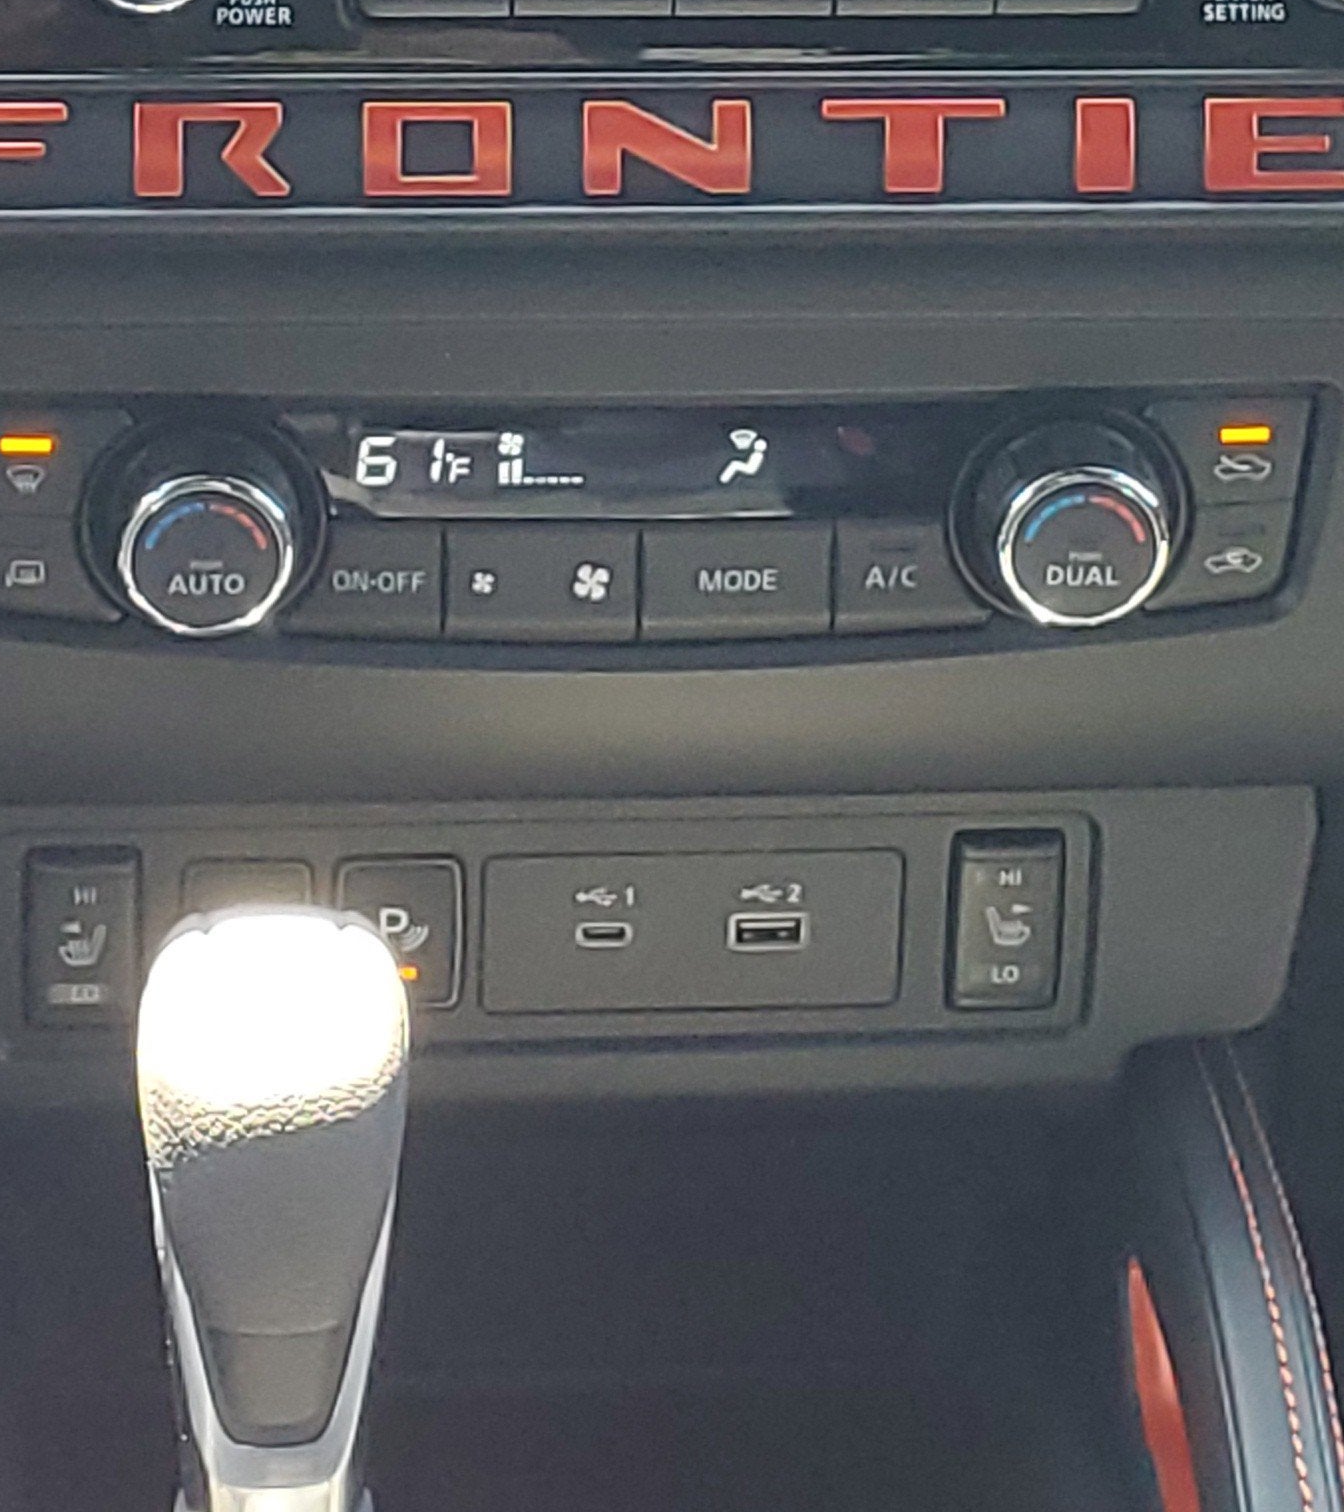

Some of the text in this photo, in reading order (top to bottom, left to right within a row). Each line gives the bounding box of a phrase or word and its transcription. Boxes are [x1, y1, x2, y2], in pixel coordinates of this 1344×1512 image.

[216, 6, 292, 26] POWER
[1203, 2, 1286, 22] SETTING
[168, 573, 245, 595] AUTO
[698, 568, 779, 592] MODE
[864, 565, 918, 590] A/C
[1046, 564, 1121, 587] DUAL
[999, 869, 1022, 886] HI
[787, 883, 803, 905] 2
[378, 908, 409, 940] P
[991, 964, 1020, 984] LO
